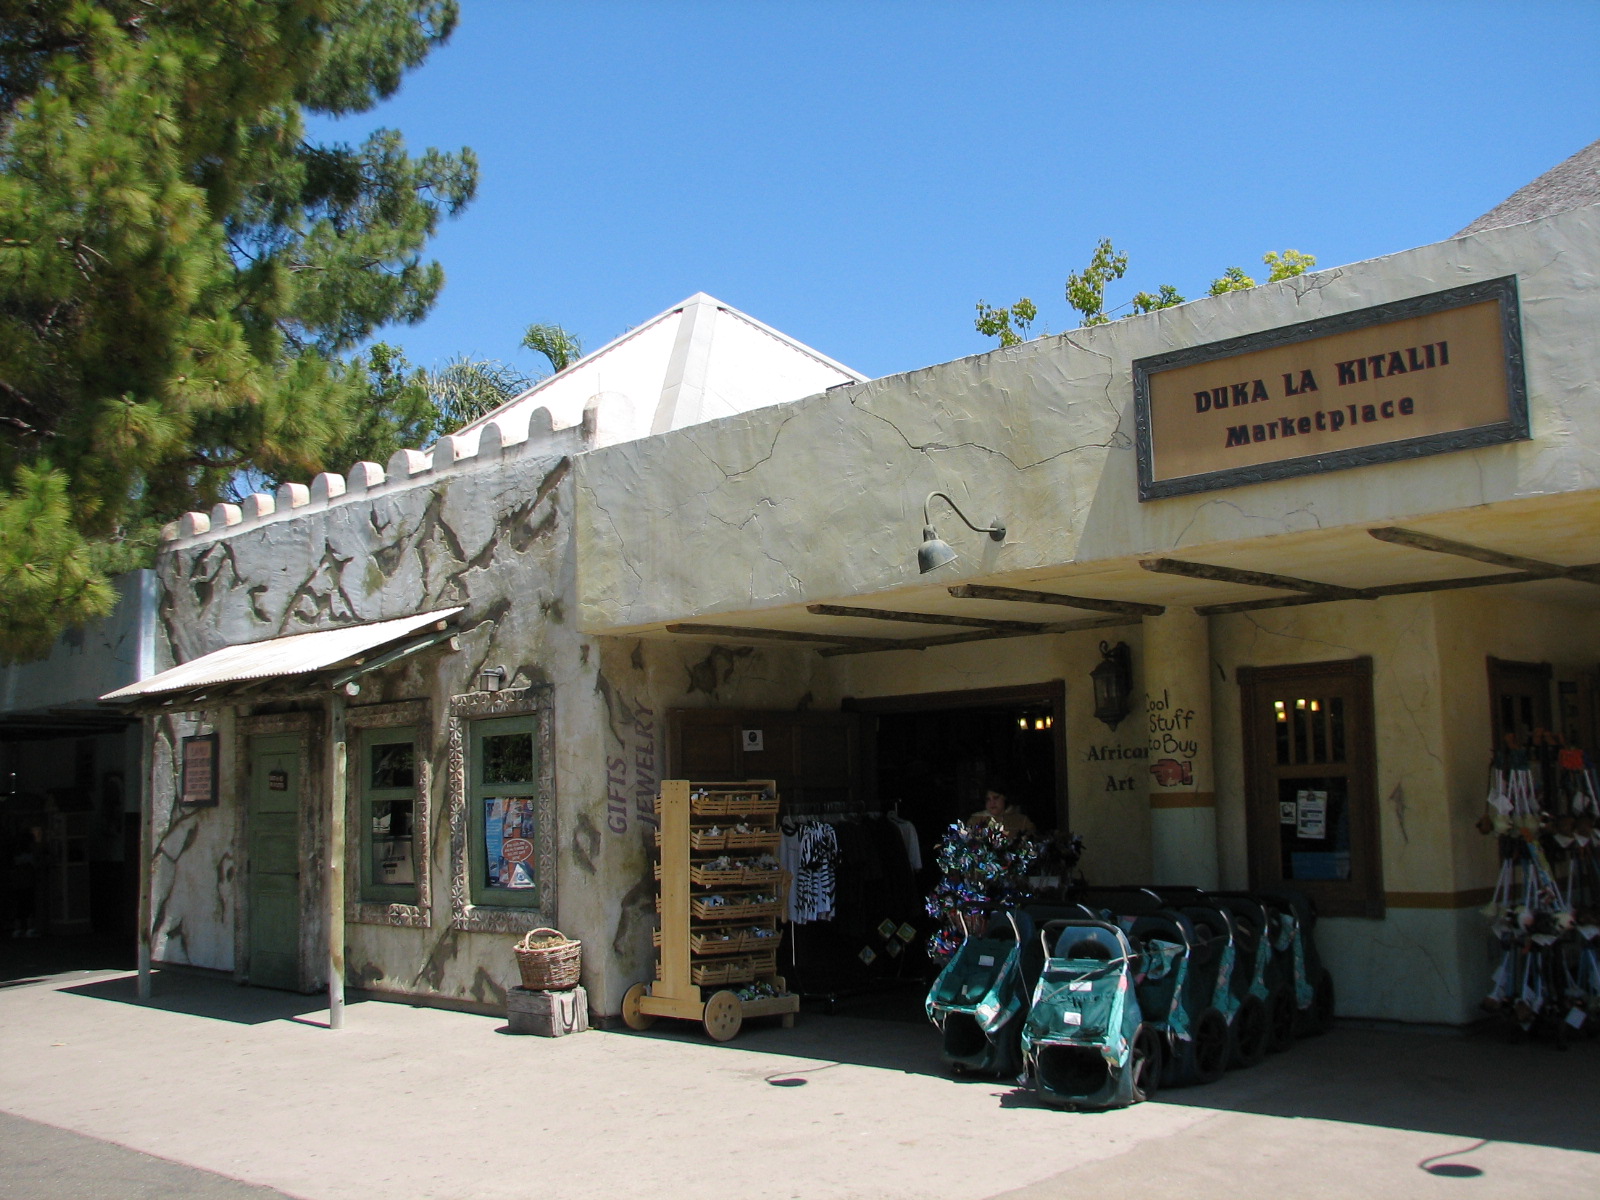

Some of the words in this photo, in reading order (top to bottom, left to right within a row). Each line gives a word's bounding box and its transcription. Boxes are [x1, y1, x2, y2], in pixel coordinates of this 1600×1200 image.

[1194, 379, 1269, 414] DUKA
[1282, 369, 1318, 397] LA
[1335, 341, 1449, 386] KITALII
[1225, 396, 1415, 448] Marketplace
[1149, 708, 1195, 733] Stuff
[1163, 733, 1197, 759] Buy
[634, 697, 660, 828] JEWELRY
[1105, 775, 1135, 792] Art
[606, 755, 628, 834] GIFTS
